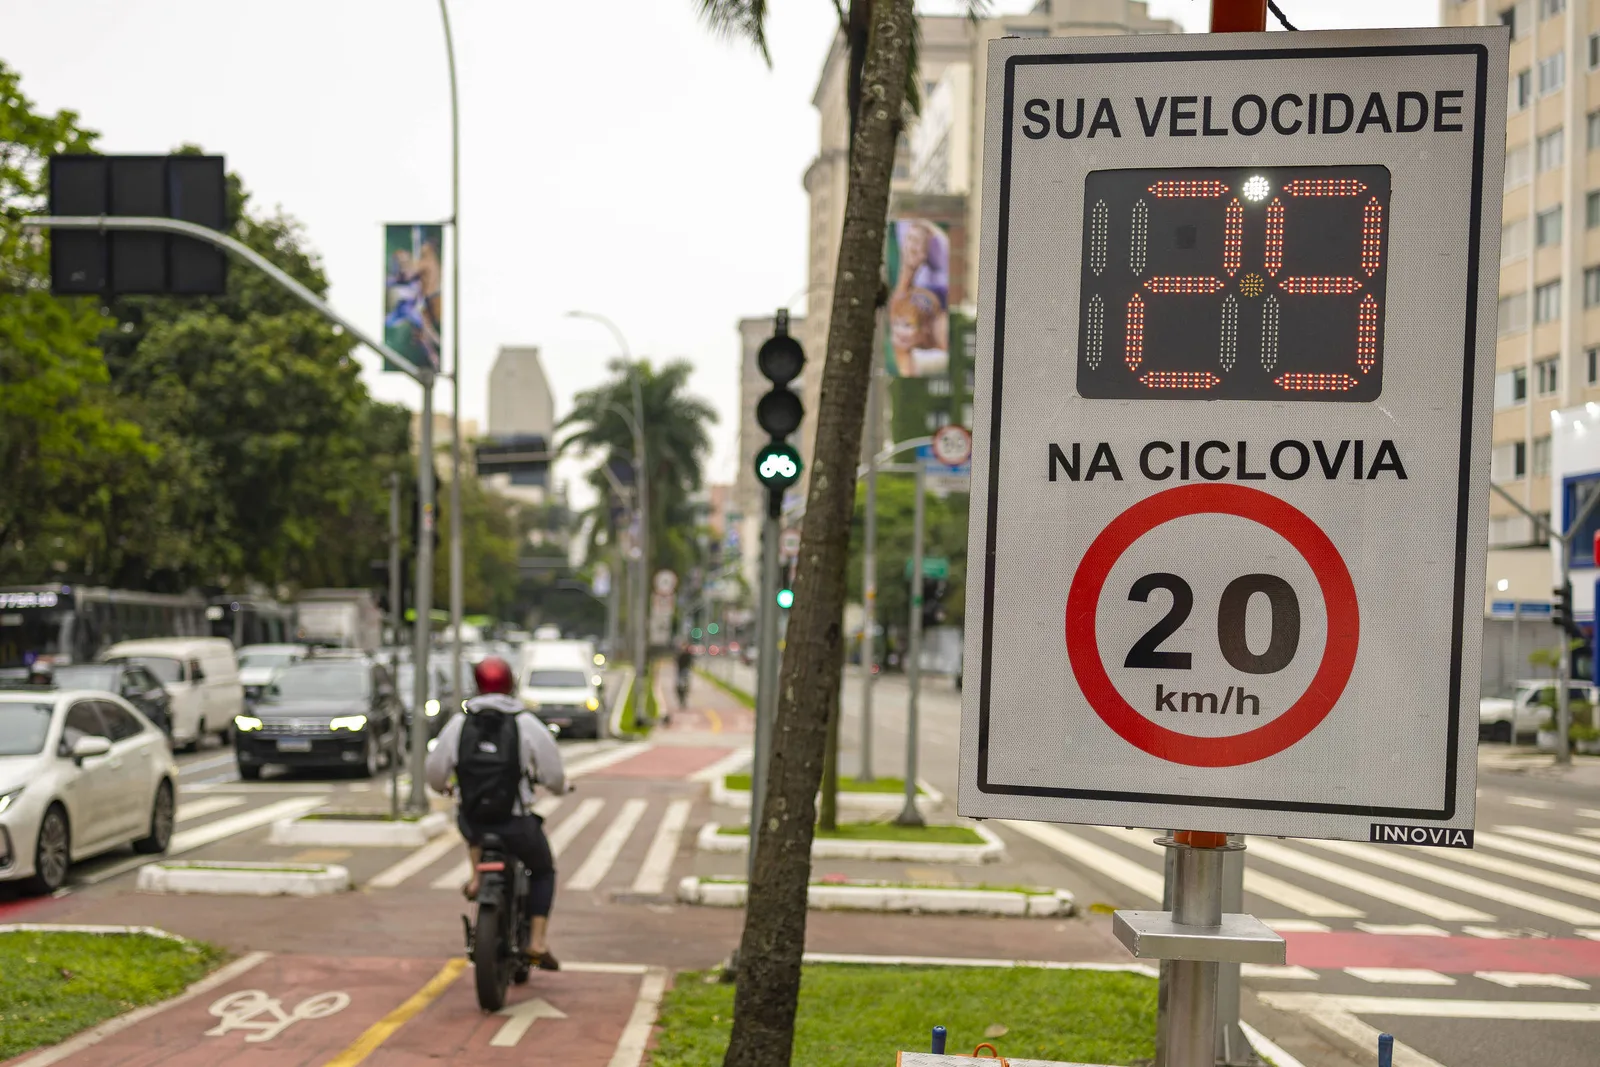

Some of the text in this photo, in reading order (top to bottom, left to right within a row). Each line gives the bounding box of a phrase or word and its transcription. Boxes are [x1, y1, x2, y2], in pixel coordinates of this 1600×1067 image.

[1022, 89, 1464, 140] SUA VELOCIDADE
[1125, 178, 1383, 391] 29
[1048, 439, 1409, 482] NA CICLOVIA
[1123, 572, 1301, 675] 20
[1155, 683, 1260, 716] km/h
[1375, 825, 1468, 846] INNOVIA
